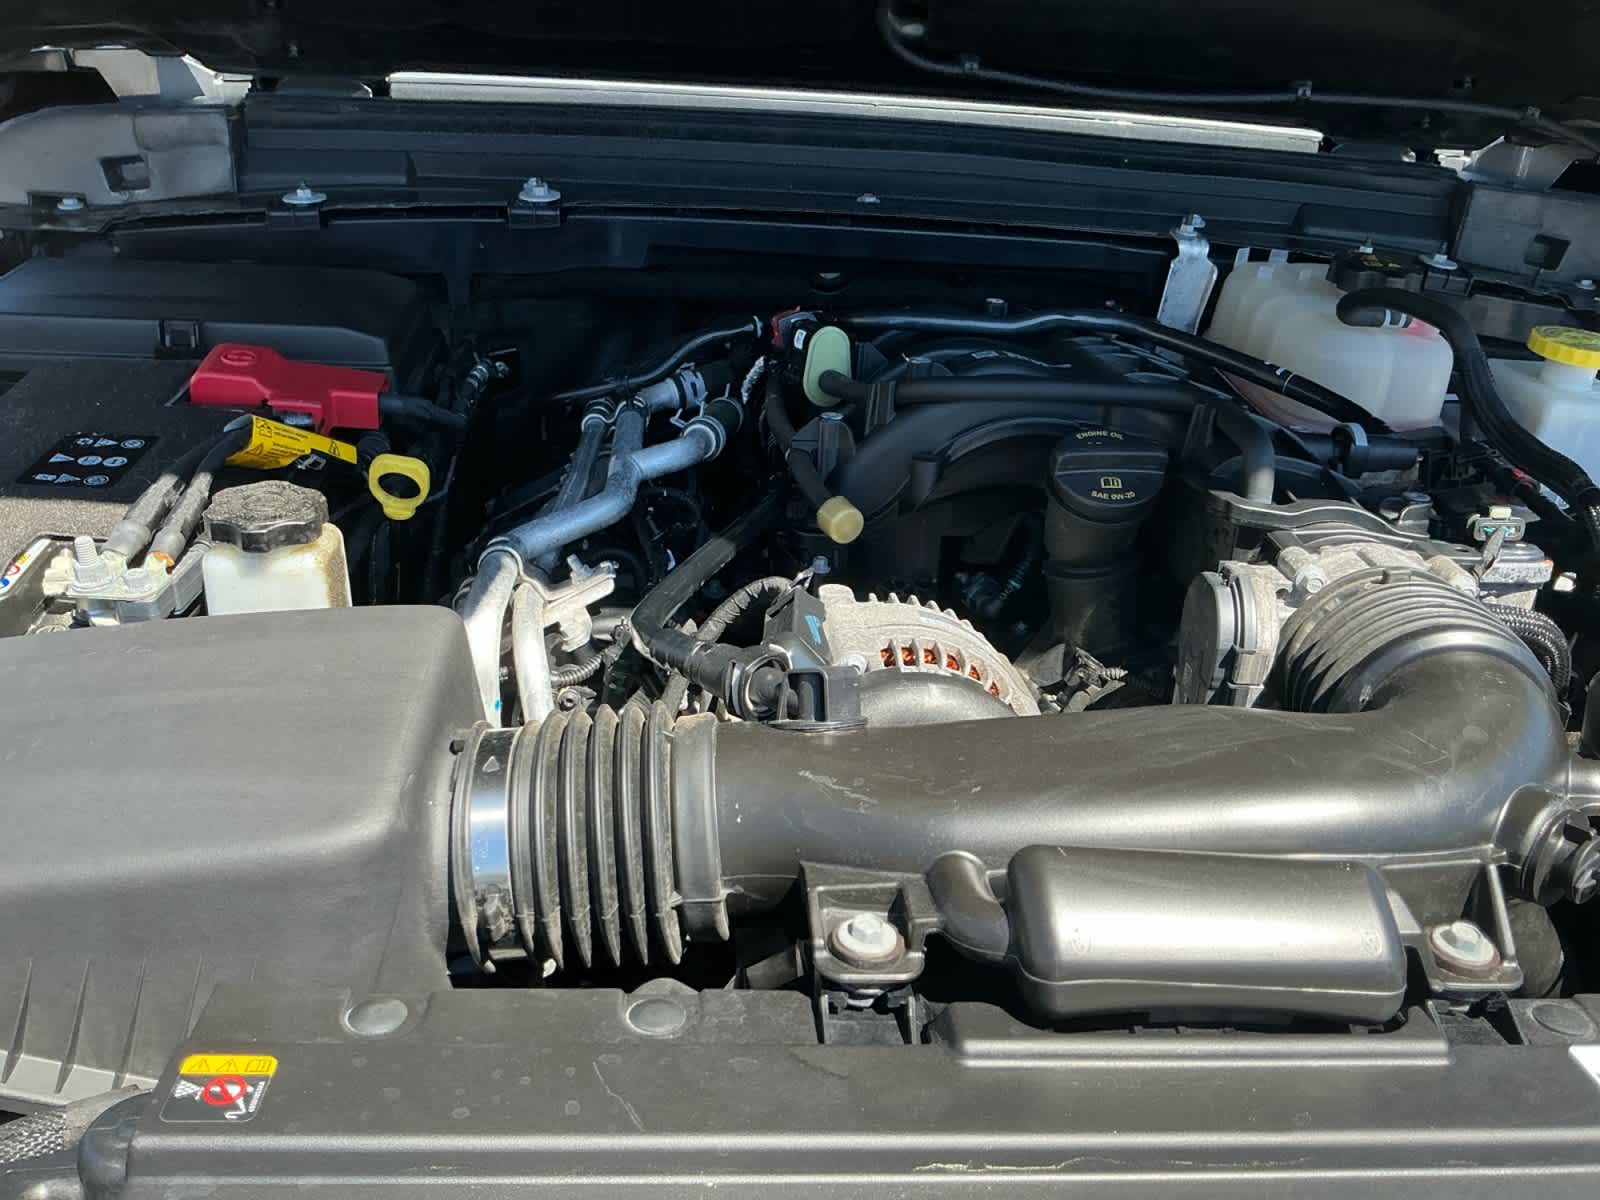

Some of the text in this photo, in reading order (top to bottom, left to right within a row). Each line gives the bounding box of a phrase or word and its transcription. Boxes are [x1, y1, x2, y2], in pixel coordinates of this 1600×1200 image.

[1076, 430, 1124, 440] ENGINE OIL
[1091, 490, 1109, 500] SAE
